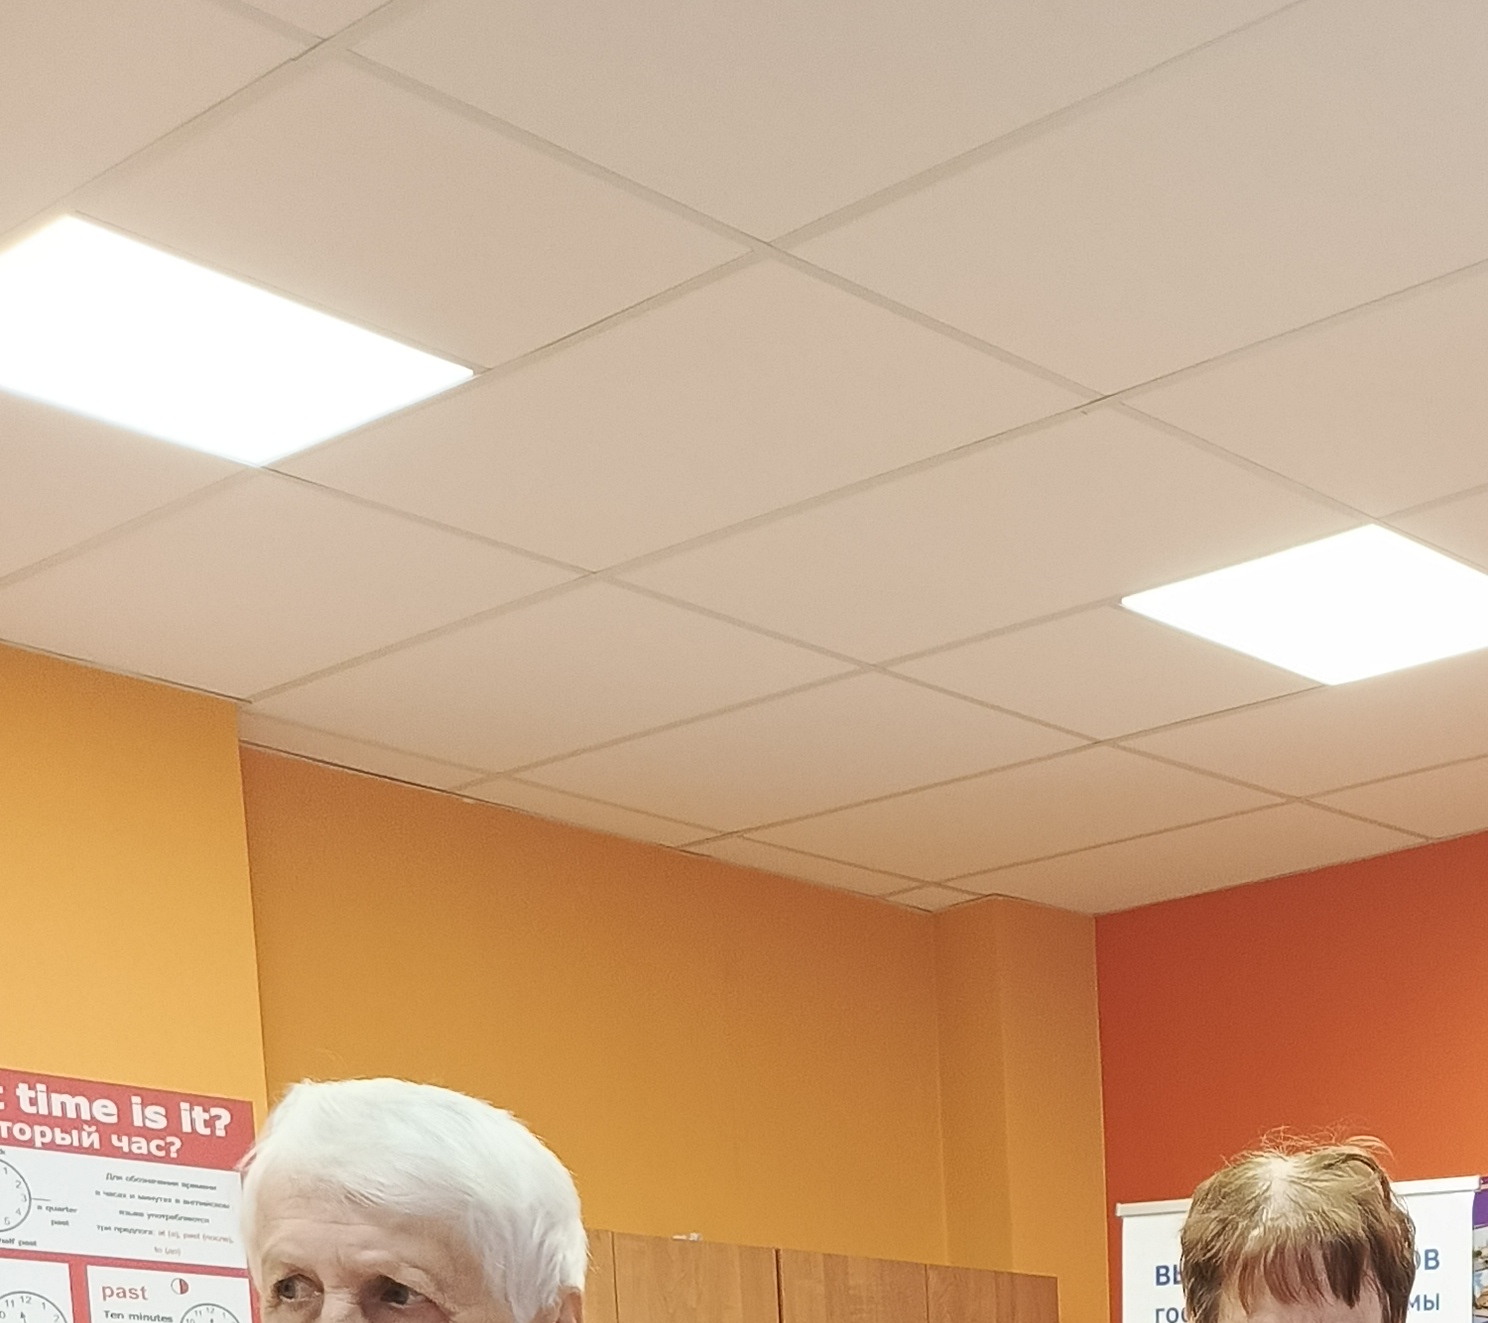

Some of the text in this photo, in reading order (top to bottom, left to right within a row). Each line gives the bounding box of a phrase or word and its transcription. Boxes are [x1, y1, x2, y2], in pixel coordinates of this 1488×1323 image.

[16, 1083, 118, 1124] time
[131, 1096, 168, 1129] is
[180, 1102, 232, 1137] it?
[111, 1134, 182, 1158] час?
[20, 1296, 32, 1304] 12
[102, 1286, 148, 1301] past
[5, 1299, 15, 1308] 11
[53, 1314, 60, 1323] 2
[104, 1310, 174, 1323] Ten minutes
